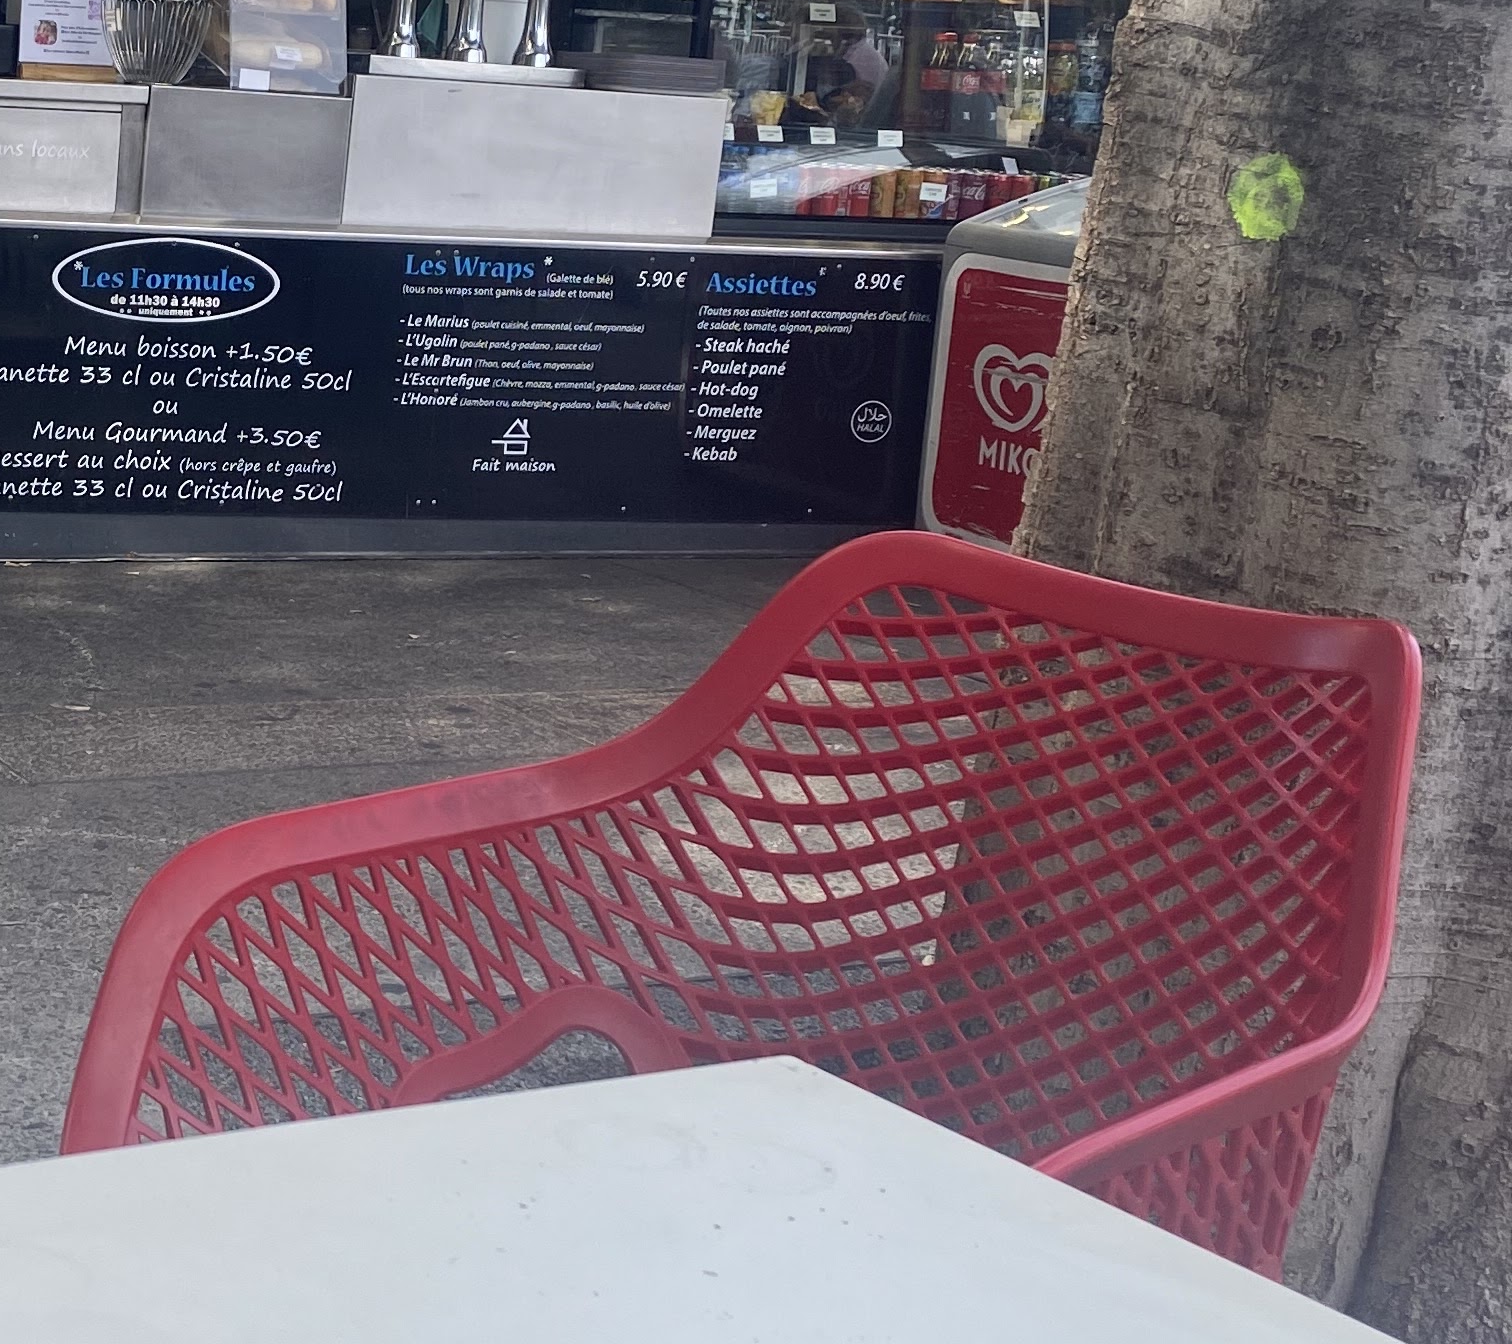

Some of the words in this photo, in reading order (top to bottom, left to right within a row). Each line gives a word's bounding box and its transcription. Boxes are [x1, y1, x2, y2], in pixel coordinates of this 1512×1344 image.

[31, 139, 90, 159] locaux
[405, 254, 447, 276] Les
[454, 255, 535, 283] Wraps
[80, 266, 124, 289] Les
[131, 267, 255, 293] Formules
[636, 271, 673, 288] 5.90
[706, 272, 817, 297] Assiettes
[854, 273, 891, 290] 8.90
[111, 294, 126, 306] de
[129, 295, 168, 306] 11h30
[182, 295, 220, 307] 14h30
[138, 306, 193, 317] uniquement
[407, 315, 423, 327] Le
[425, 315, 469, 328] Marius
[64, 336, 127, 357] Menu
[137, 335, 217, 358] boisson
[226, 344, 313, 366] +1.50€
[703, 339, 744, 353] Steak
[746, 340, 790, 354] haché
[80, 365, 112, 384] 33
[122, 365, 140, 385] cl
[150, 369, 175, 386] ou
[186, 367, 292, 389] Cristaline
[301, 370, 353, 392] 50cl
[857, 423, 885, 434] HALAL
[692, 447, 738, 462] Kebab
[472, 458, 501, 472] Fait
[505, 459, 556, 472] maison
